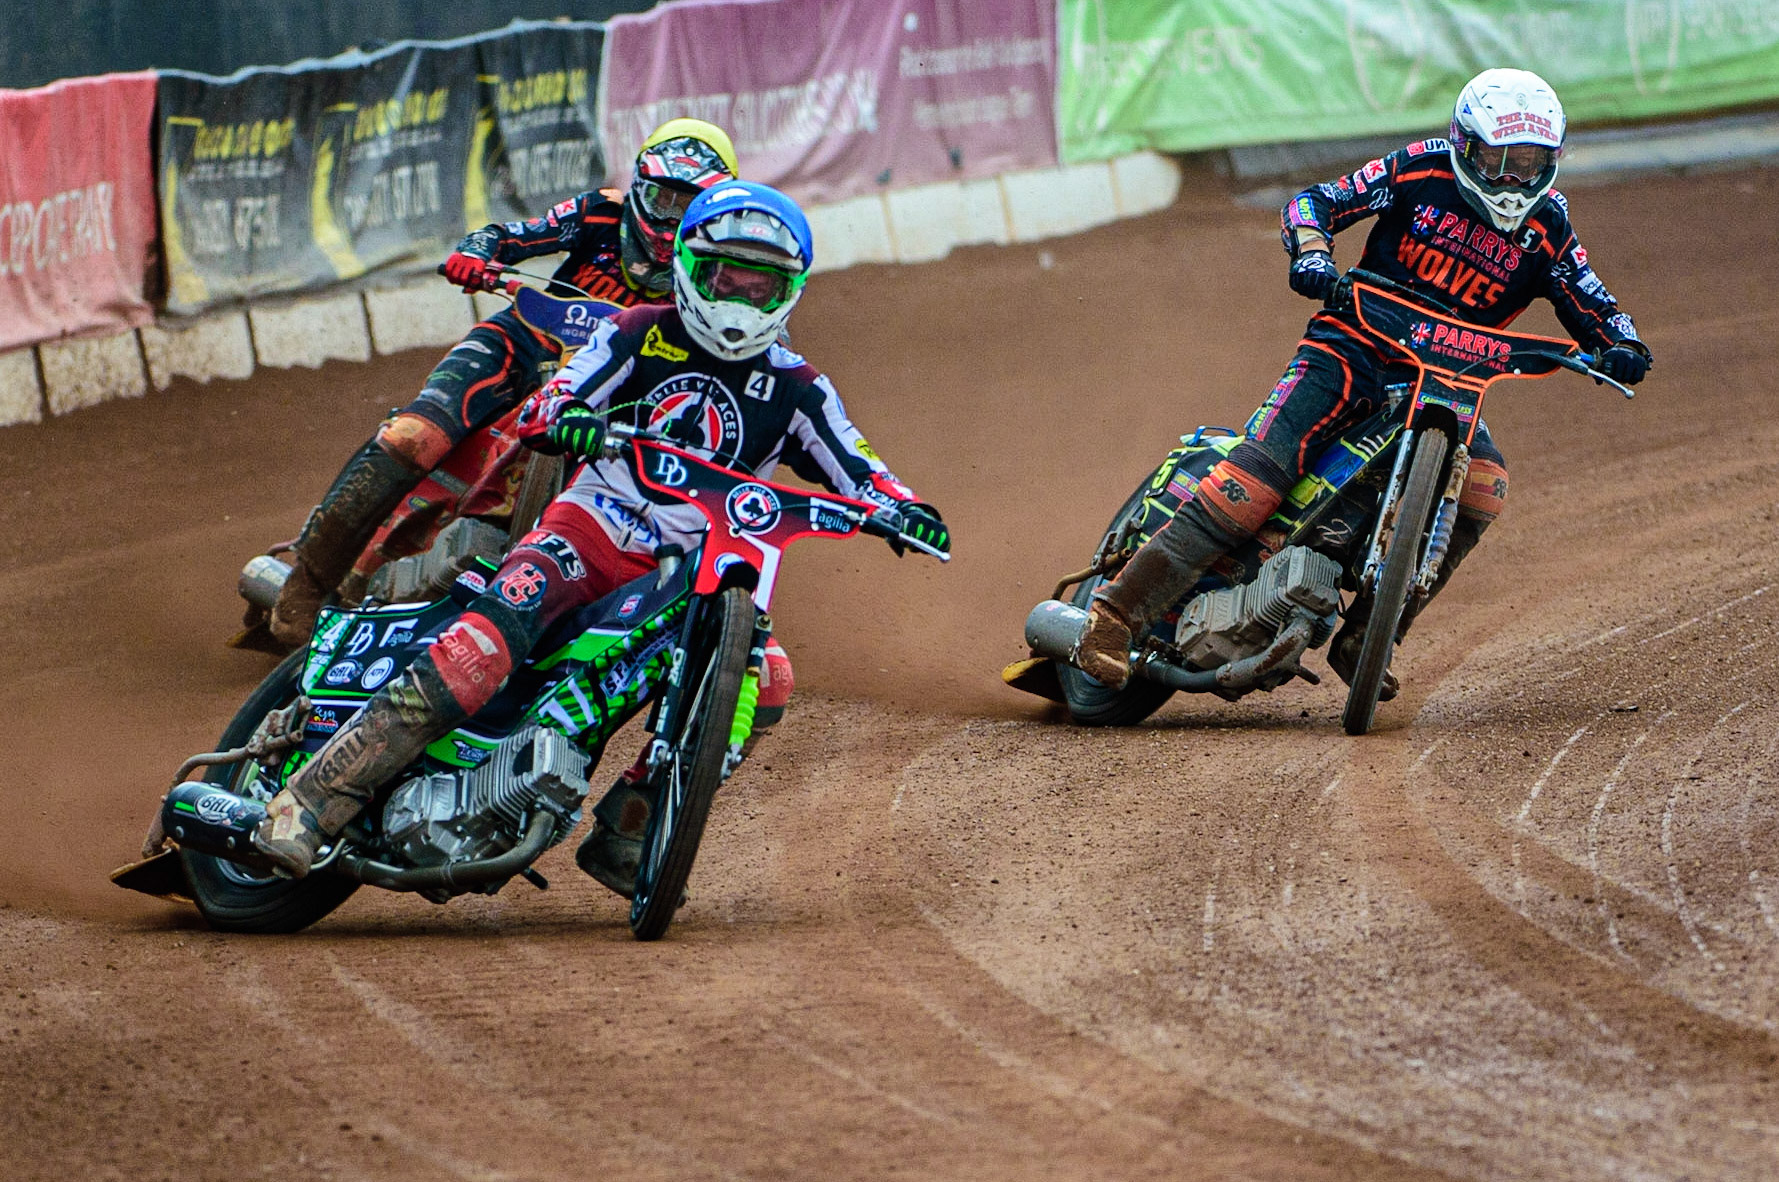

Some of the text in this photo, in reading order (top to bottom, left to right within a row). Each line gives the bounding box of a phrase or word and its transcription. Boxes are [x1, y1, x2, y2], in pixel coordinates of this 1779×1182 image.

[1496, 112, 1522, 126] THE
[1520, 228, 1536, 249] 5
[1397, 233, 1506, 309] WOLVES
[1433, 323, 1512, 362] PARRYS
[751, 375, 768, 398] 4
[718, 402, 737, 440] ACES
[1152, 458, 1178, 489] 5
[818, 513, 851, 533] agilia
[444, 636, 487, 684] agilia
